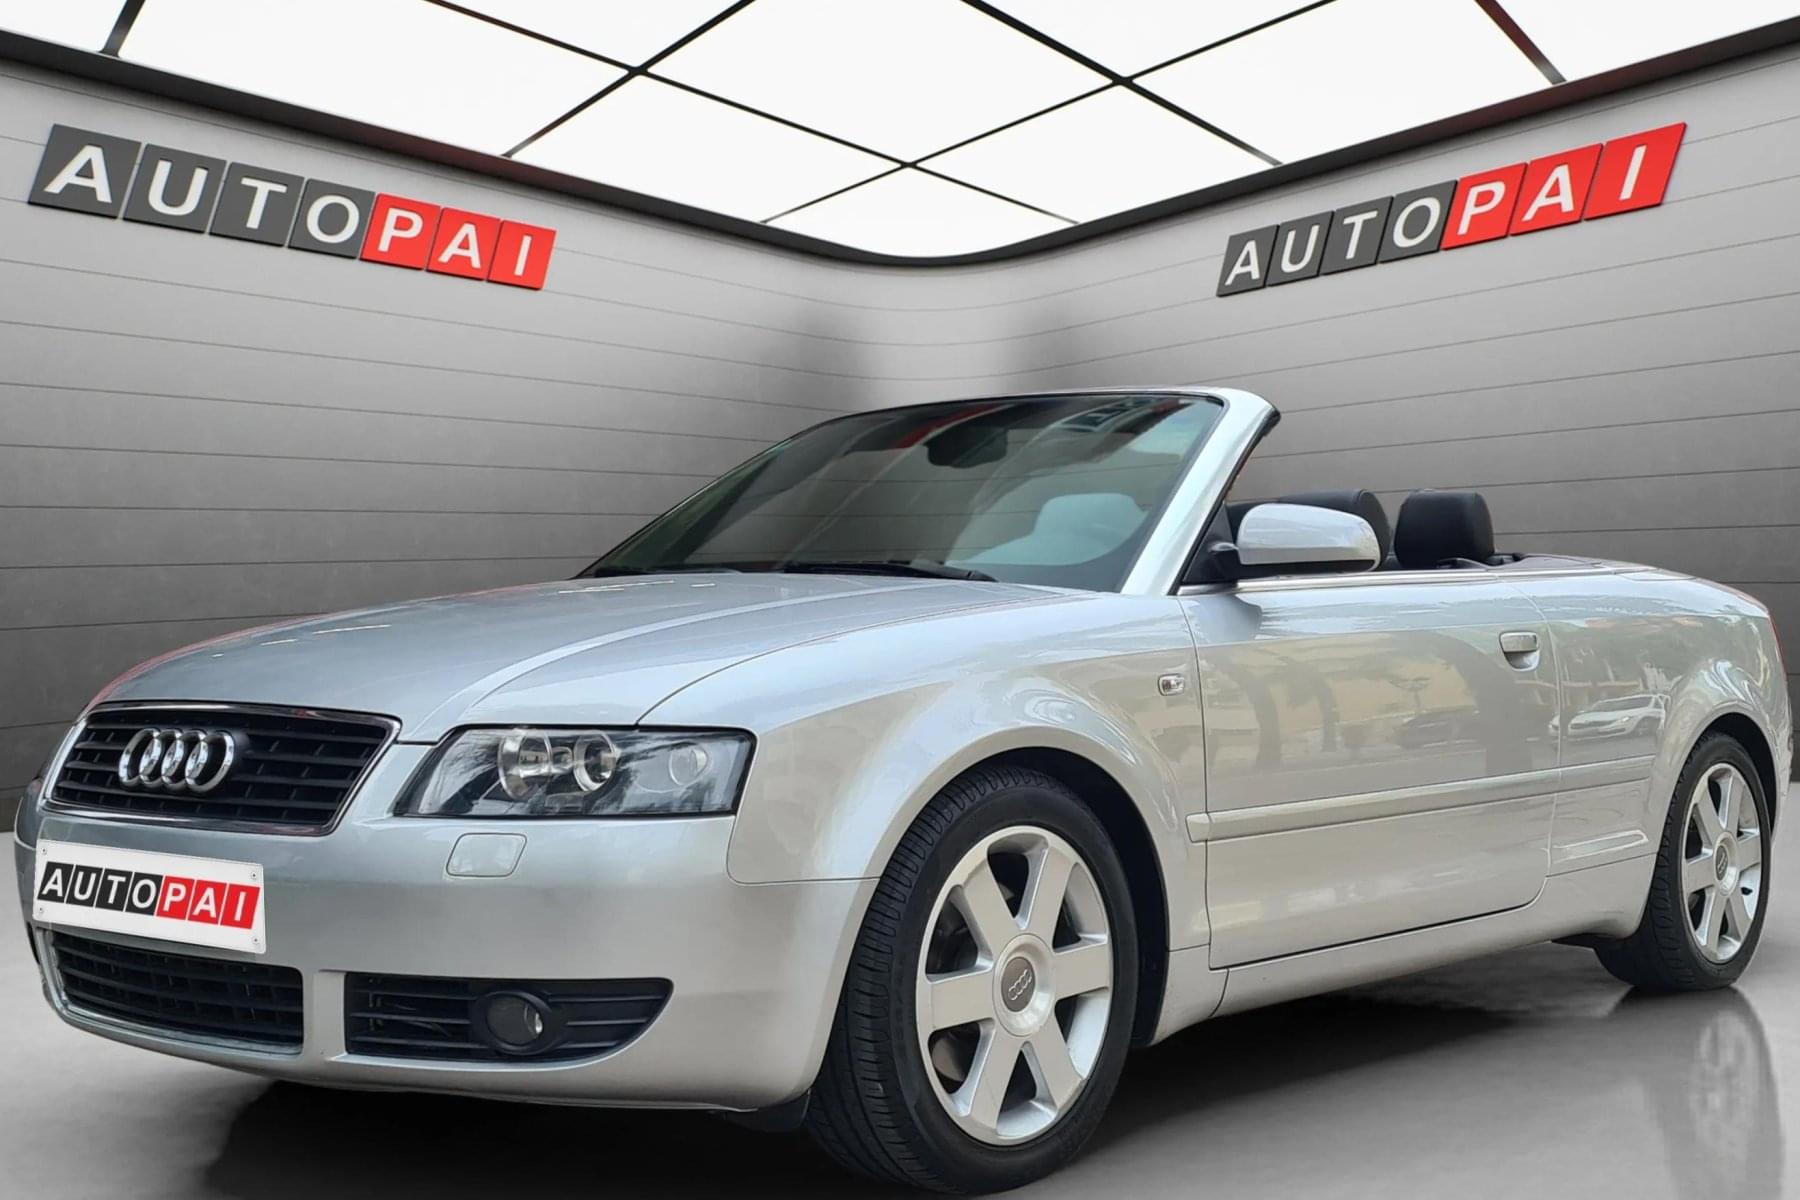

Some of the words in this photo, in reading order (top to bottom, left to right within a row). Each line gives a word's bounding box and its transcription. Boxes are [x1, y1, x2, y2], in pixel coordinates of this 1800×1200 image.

[44, 145, 532, 276] AUTOPAI
[1225, 145, 1646, 285] AUTOPAI
[42, 867, 246, 921] AUTOPAI
